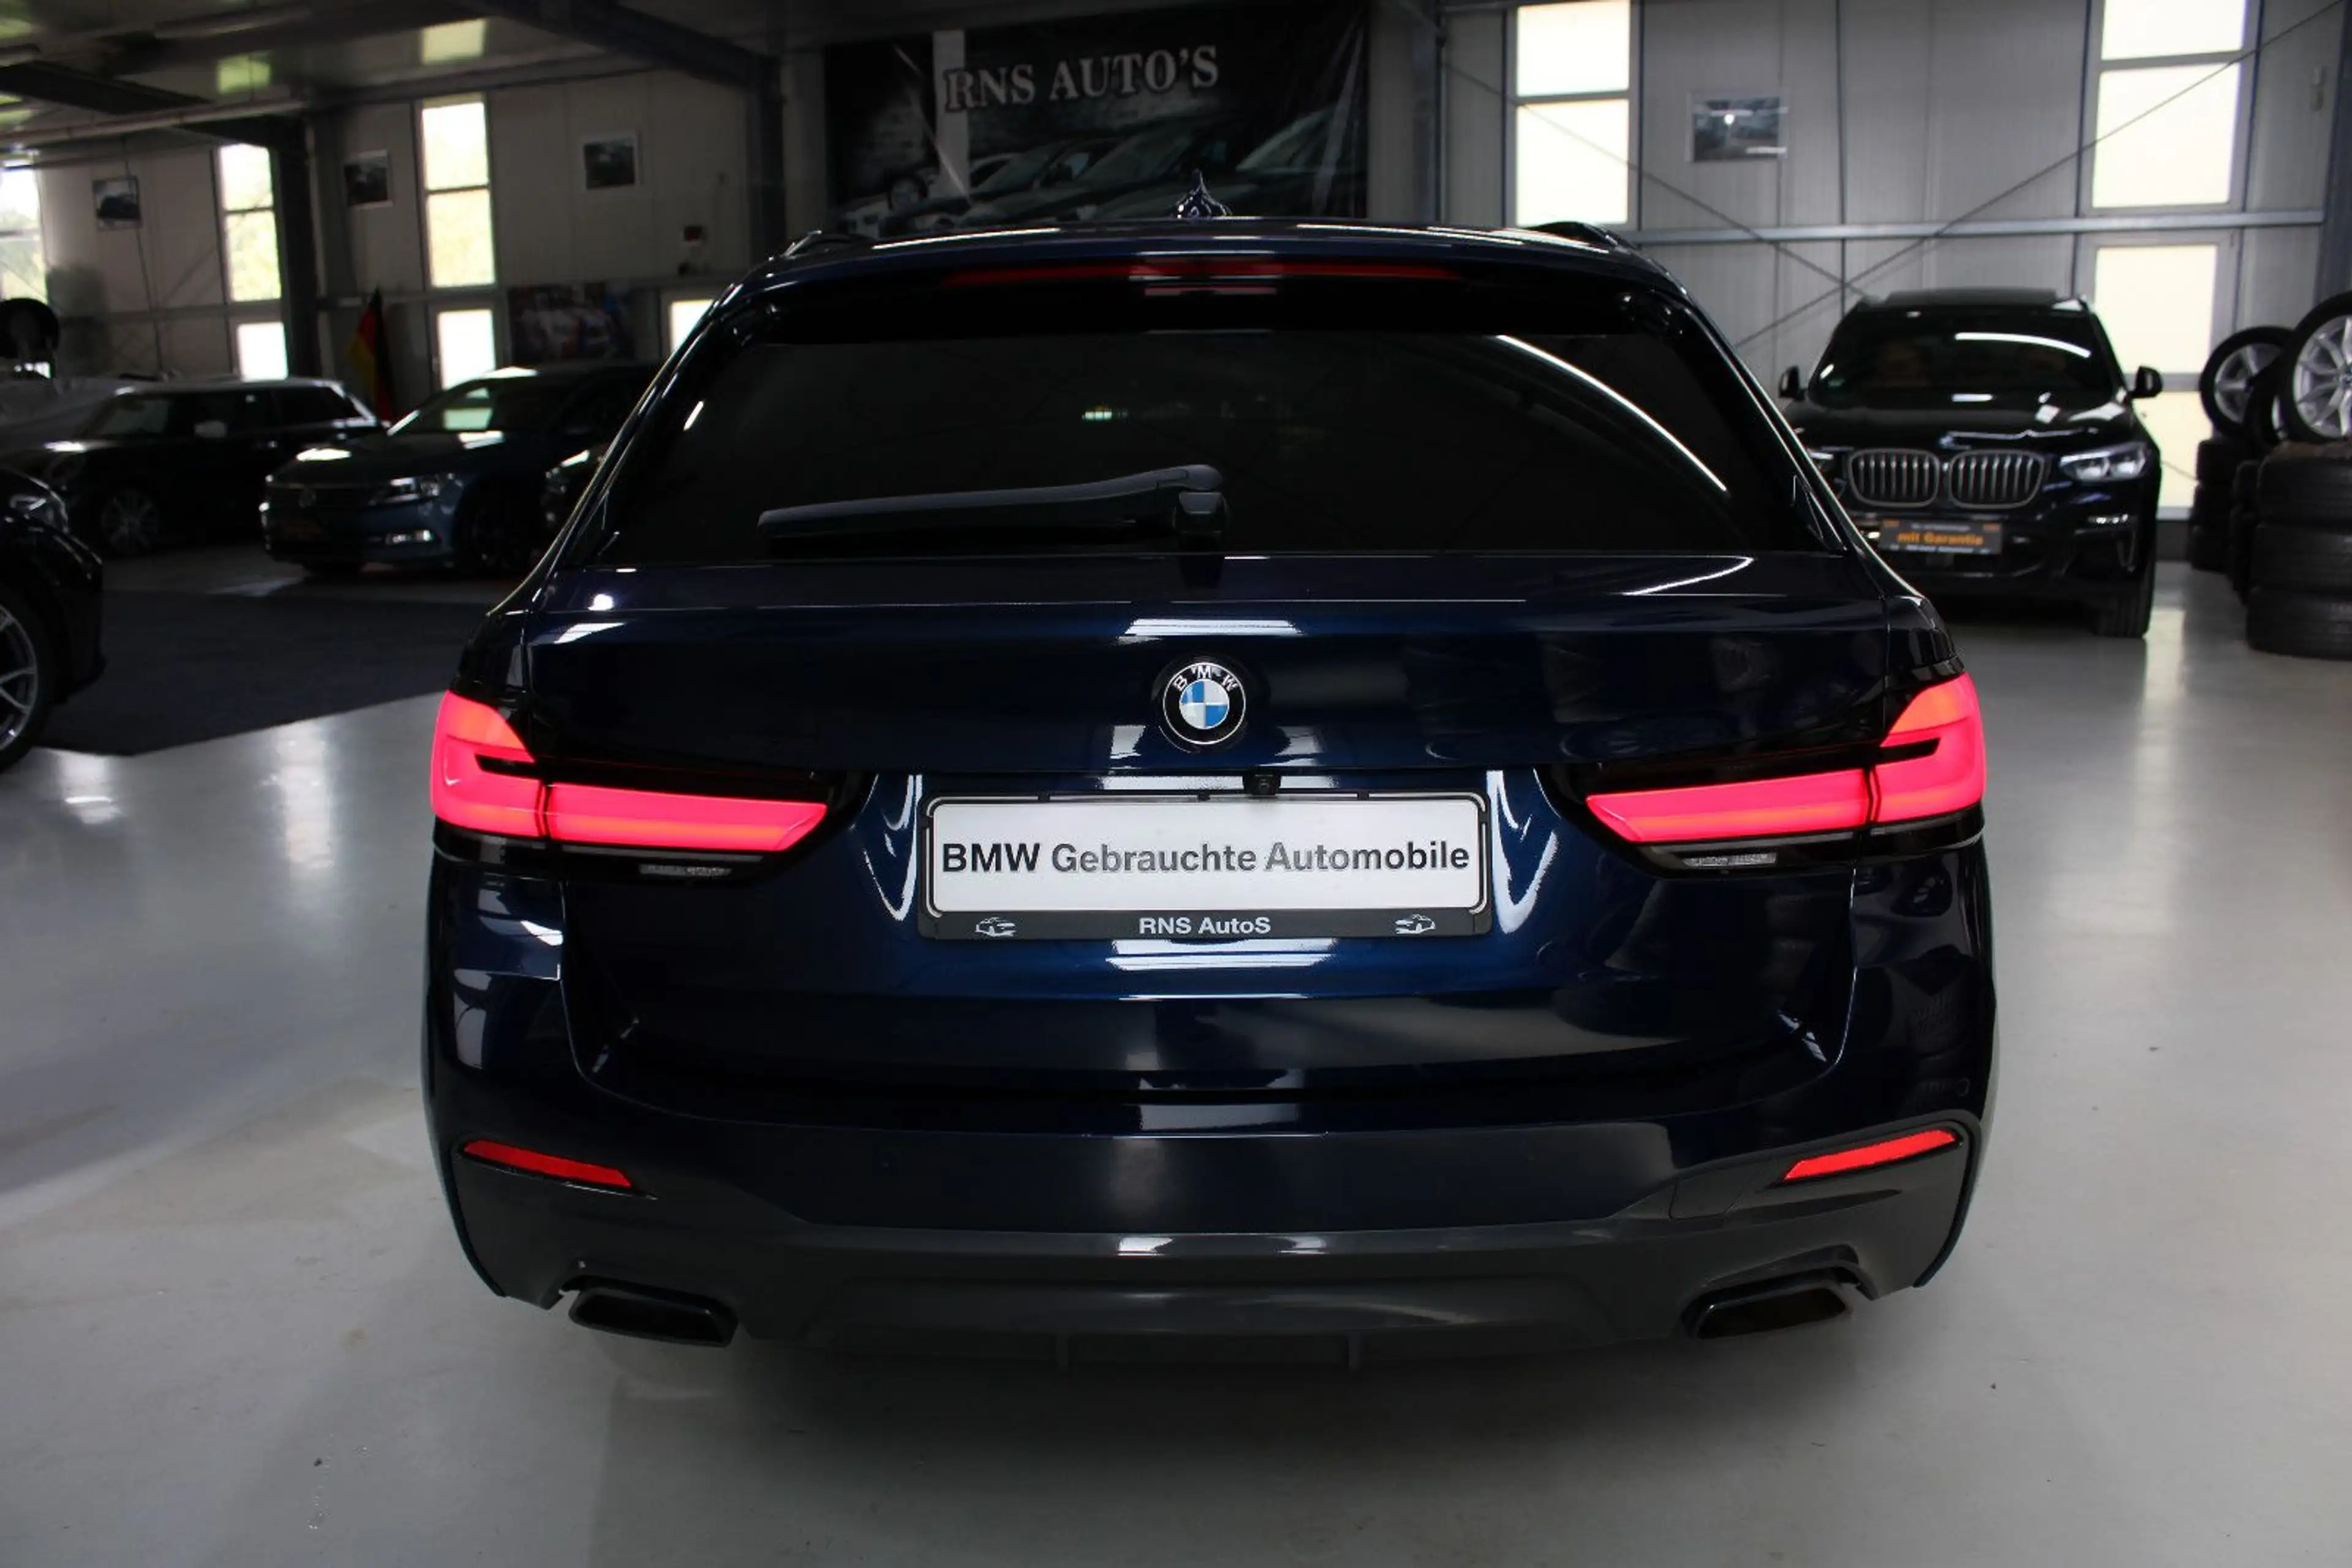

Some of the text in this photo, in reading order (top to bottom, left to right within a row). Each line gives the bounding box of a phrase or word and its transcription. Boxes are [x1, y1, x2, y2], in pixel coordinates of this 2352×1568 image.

[946, 44, 1220, 111] RNS AUTO'S
[1172, 665, 1238, 692] BMW
[942, 840, 1470, 873] BMW Gebrauchte Automobile
[1139, 916, 1272, 935] RNS AutoS
